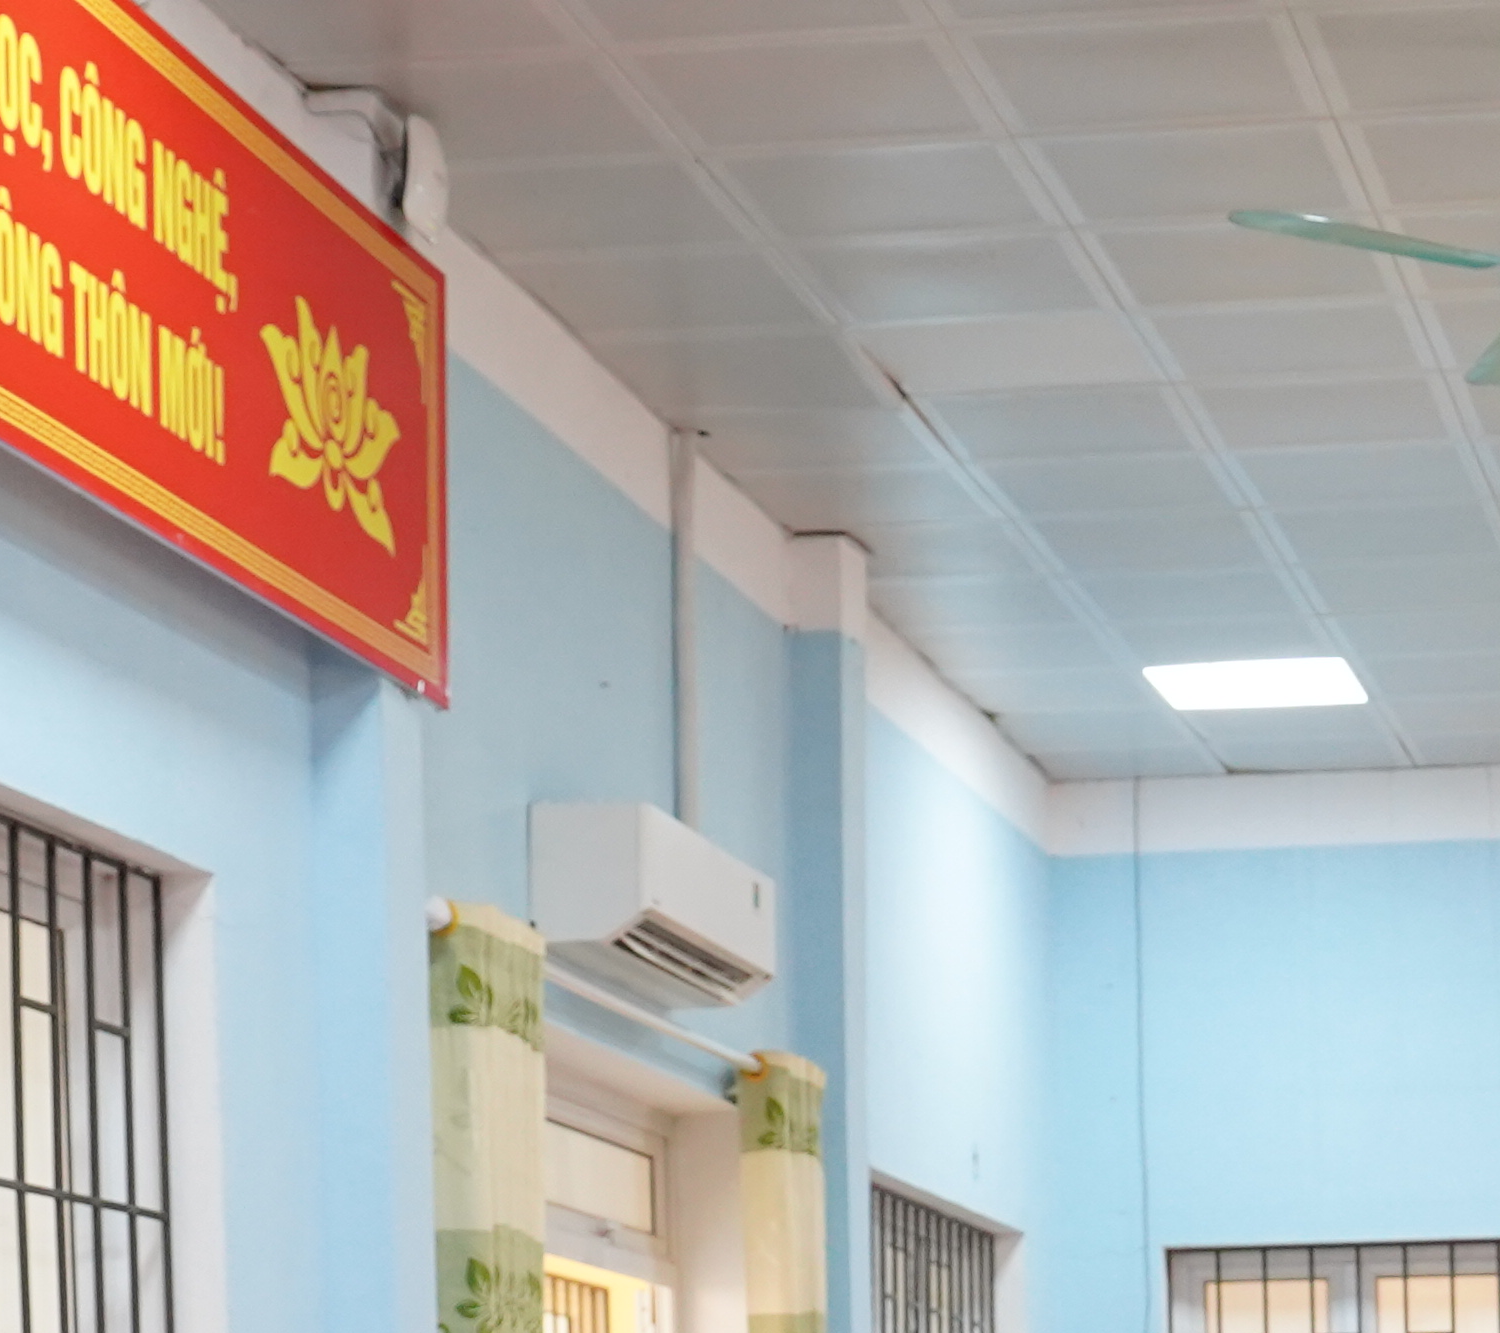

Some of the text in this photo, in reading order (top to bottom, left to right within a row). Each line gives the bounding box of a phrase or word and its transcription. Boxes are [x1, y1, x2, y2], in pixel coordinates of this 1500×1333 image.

[59, 61, 147, 231] CÔNG
[152, 138, 239, 315] NGHỆ,
[69, 259, 153, 418] THÔN
[157, 325, 227, 467] MỚI!
